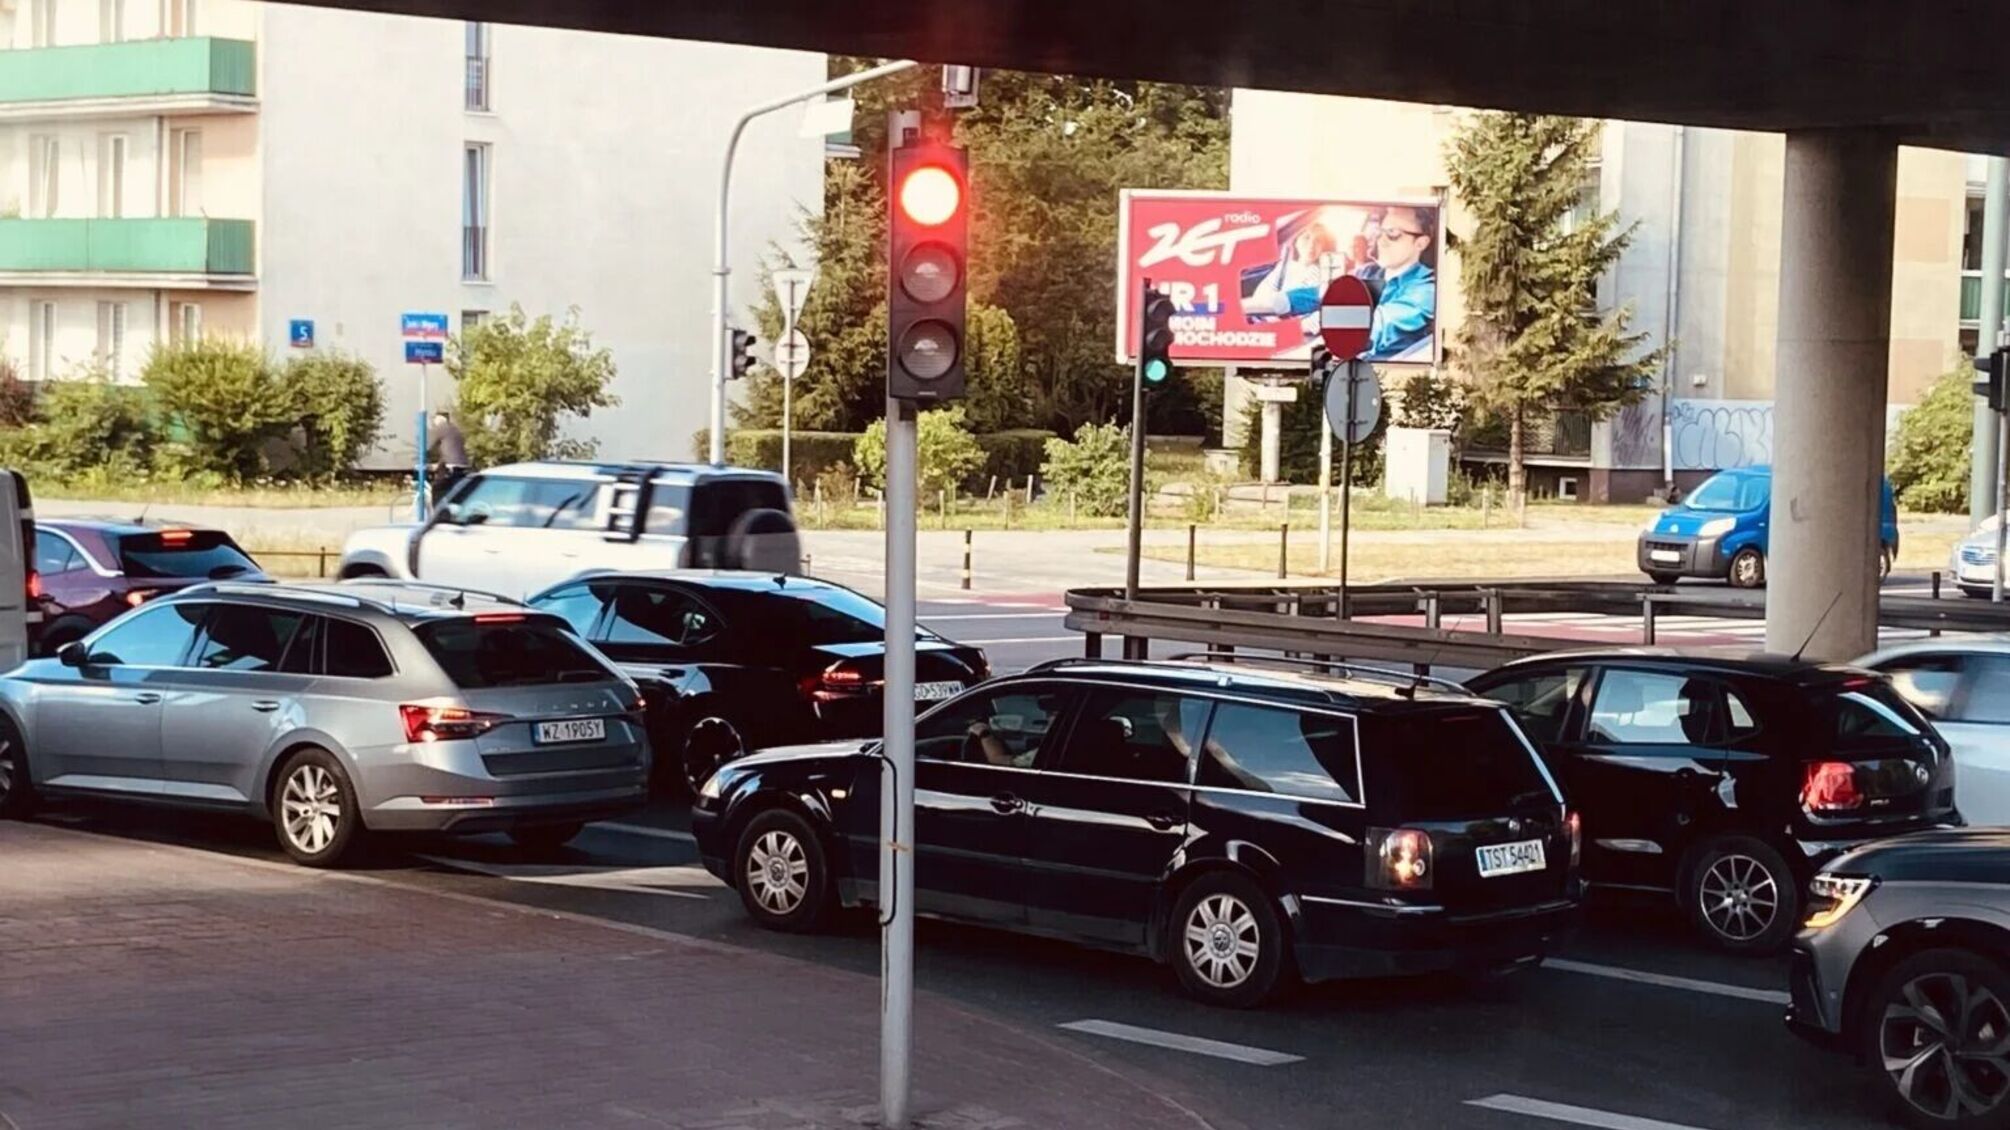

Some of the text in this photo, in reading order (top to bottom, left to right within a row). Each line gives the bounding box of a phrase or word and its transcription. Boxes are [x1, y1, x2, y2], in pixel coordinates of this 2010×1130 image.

[1224, 211, 1261, 224] radio
[1138, 217, 1270, 268] ZET
[1153, 280, 1219, 312] R 1
[299, 325, 308, 341] 5
[1485, 846, 1508, 868] TST
